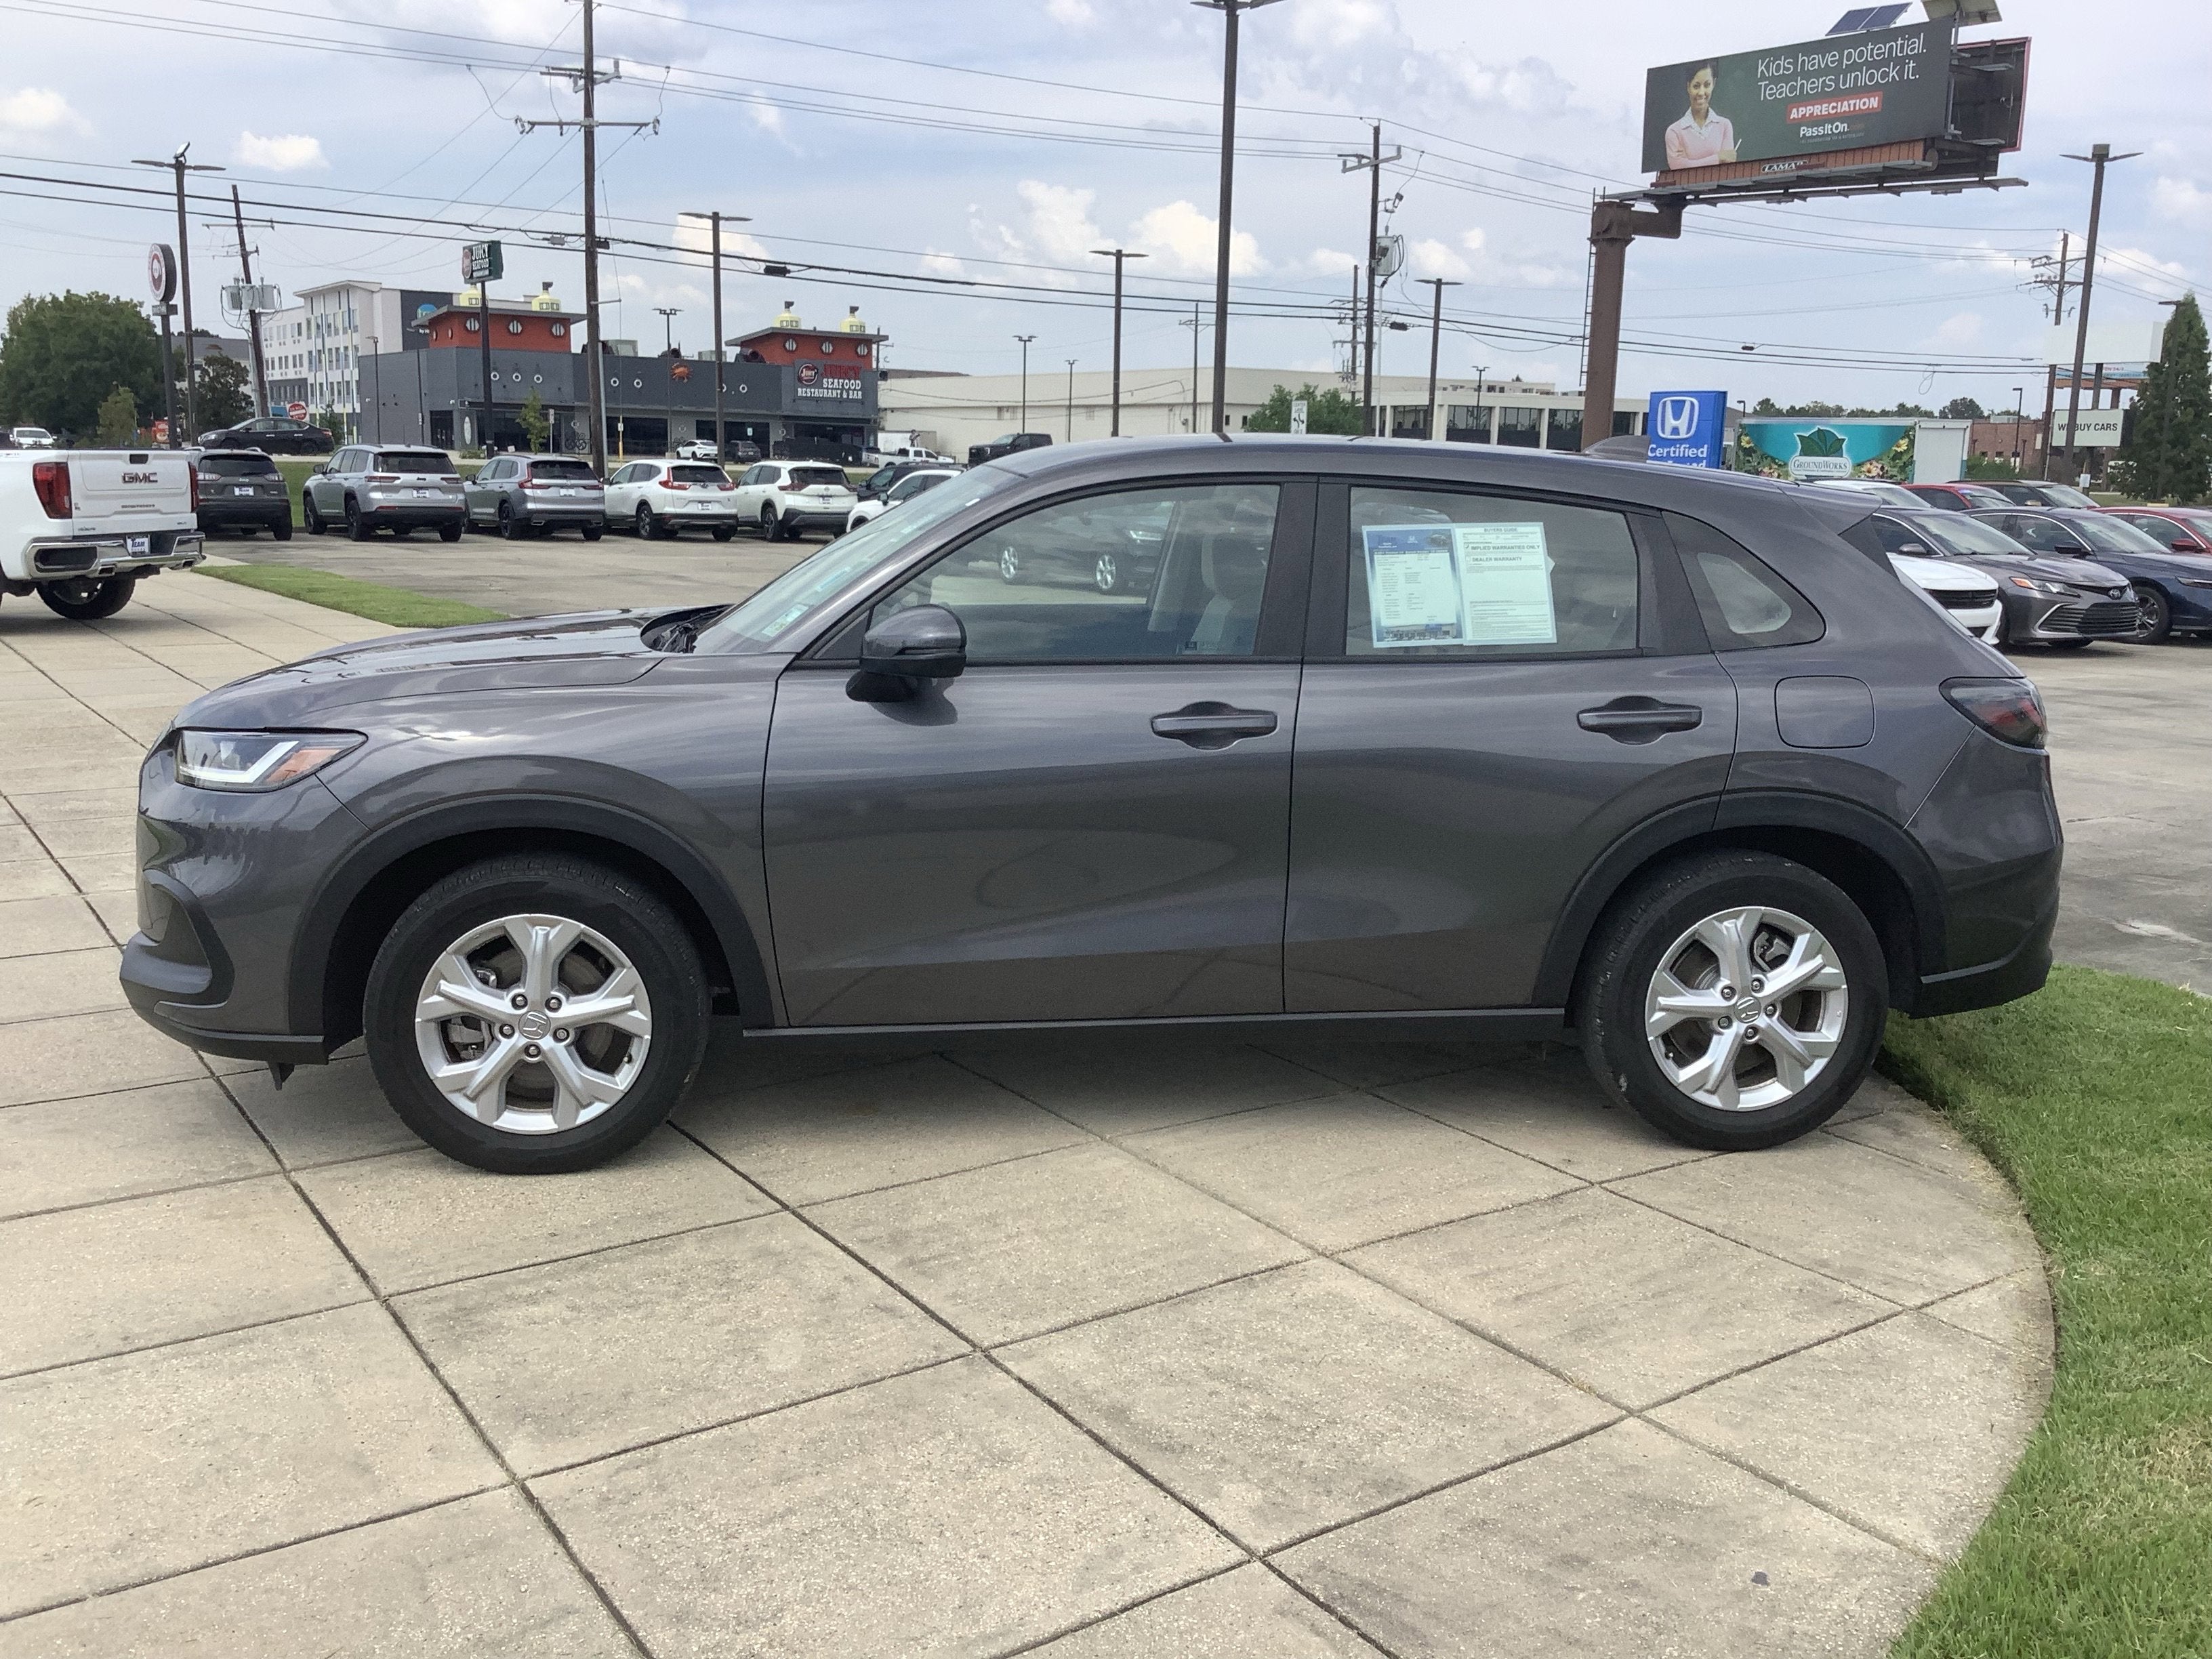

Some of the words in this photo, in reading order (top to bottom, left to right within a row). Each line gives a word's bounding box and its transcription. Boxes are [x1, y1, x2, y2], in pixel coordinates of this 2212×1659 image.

[1757, 56, 1794, 78] Kids
[1797, 53, 1839, 72] have
[1842, 33, 1927, 69] potential.
[1757, 75, 1835, 101] Teachers
[1839, 62, 1900, 89] unlock
[1904, 60, 1919, 80] it.
[1789, 96, 1879, 119] APPRECIATION
[472, 244, 489, 261] JUICY
[823, 378, 861, 390] SEAFOOD
[798, 388, 841, 398] RESTAURANT
[842, 390, 848, 398] &
[848, 390, 862, 399] BAR
[2074, 423, 2092, 431] BUY
[2093, 423, 2118, 431] CARS
[1647, 444, 1708, 457] Certified
[122, 472, 158, 484] GMC
